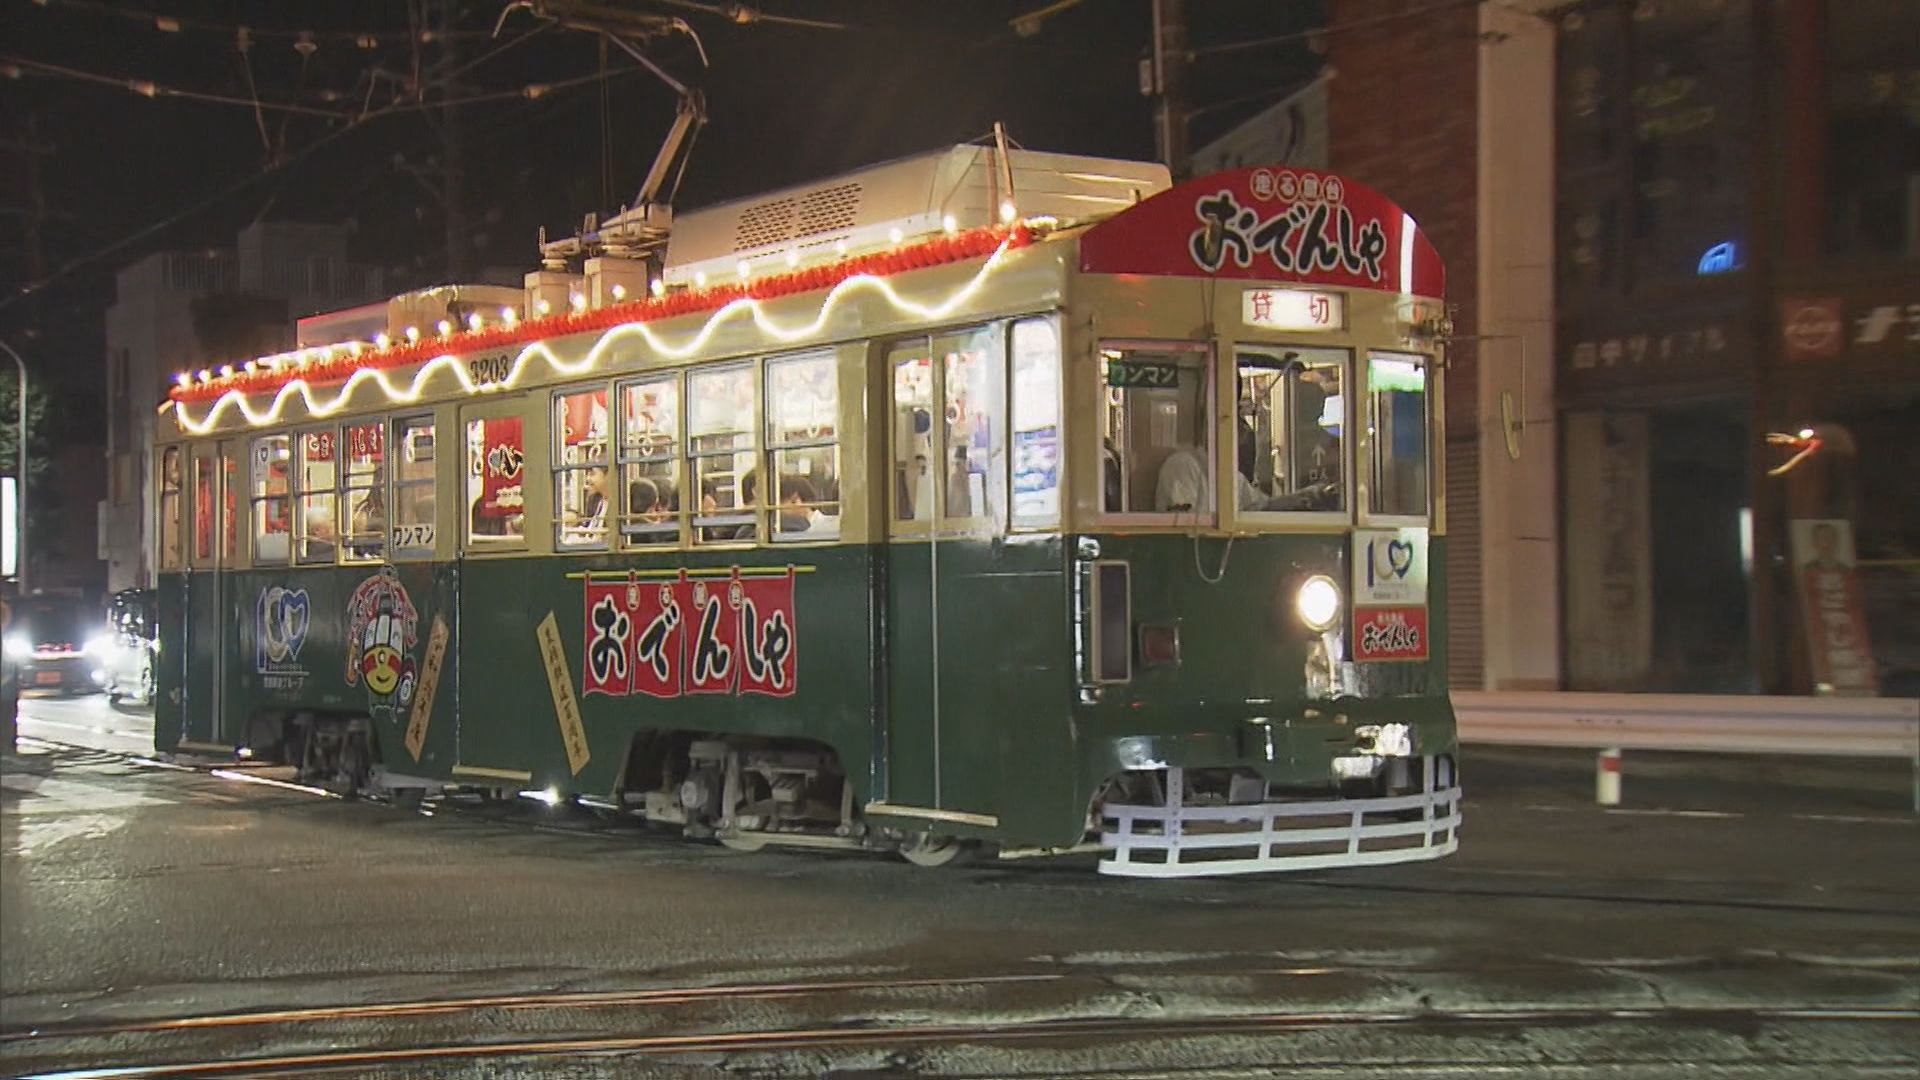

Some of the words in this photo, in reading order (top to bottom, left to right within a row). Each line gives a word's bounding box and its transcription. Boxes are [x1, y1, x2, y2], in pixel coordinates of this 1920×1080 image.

[1190, 190, 1386, 281] おでんしゃ
[1251, 291, 1330, 323] 貸切
[471, 355, 509, 385] 3203
[394, 526, 434, 546] ワンマン
[589, 593, 791, 689] おでんしゃ
[1362, 620, 1419, 654] おでんしゃ
